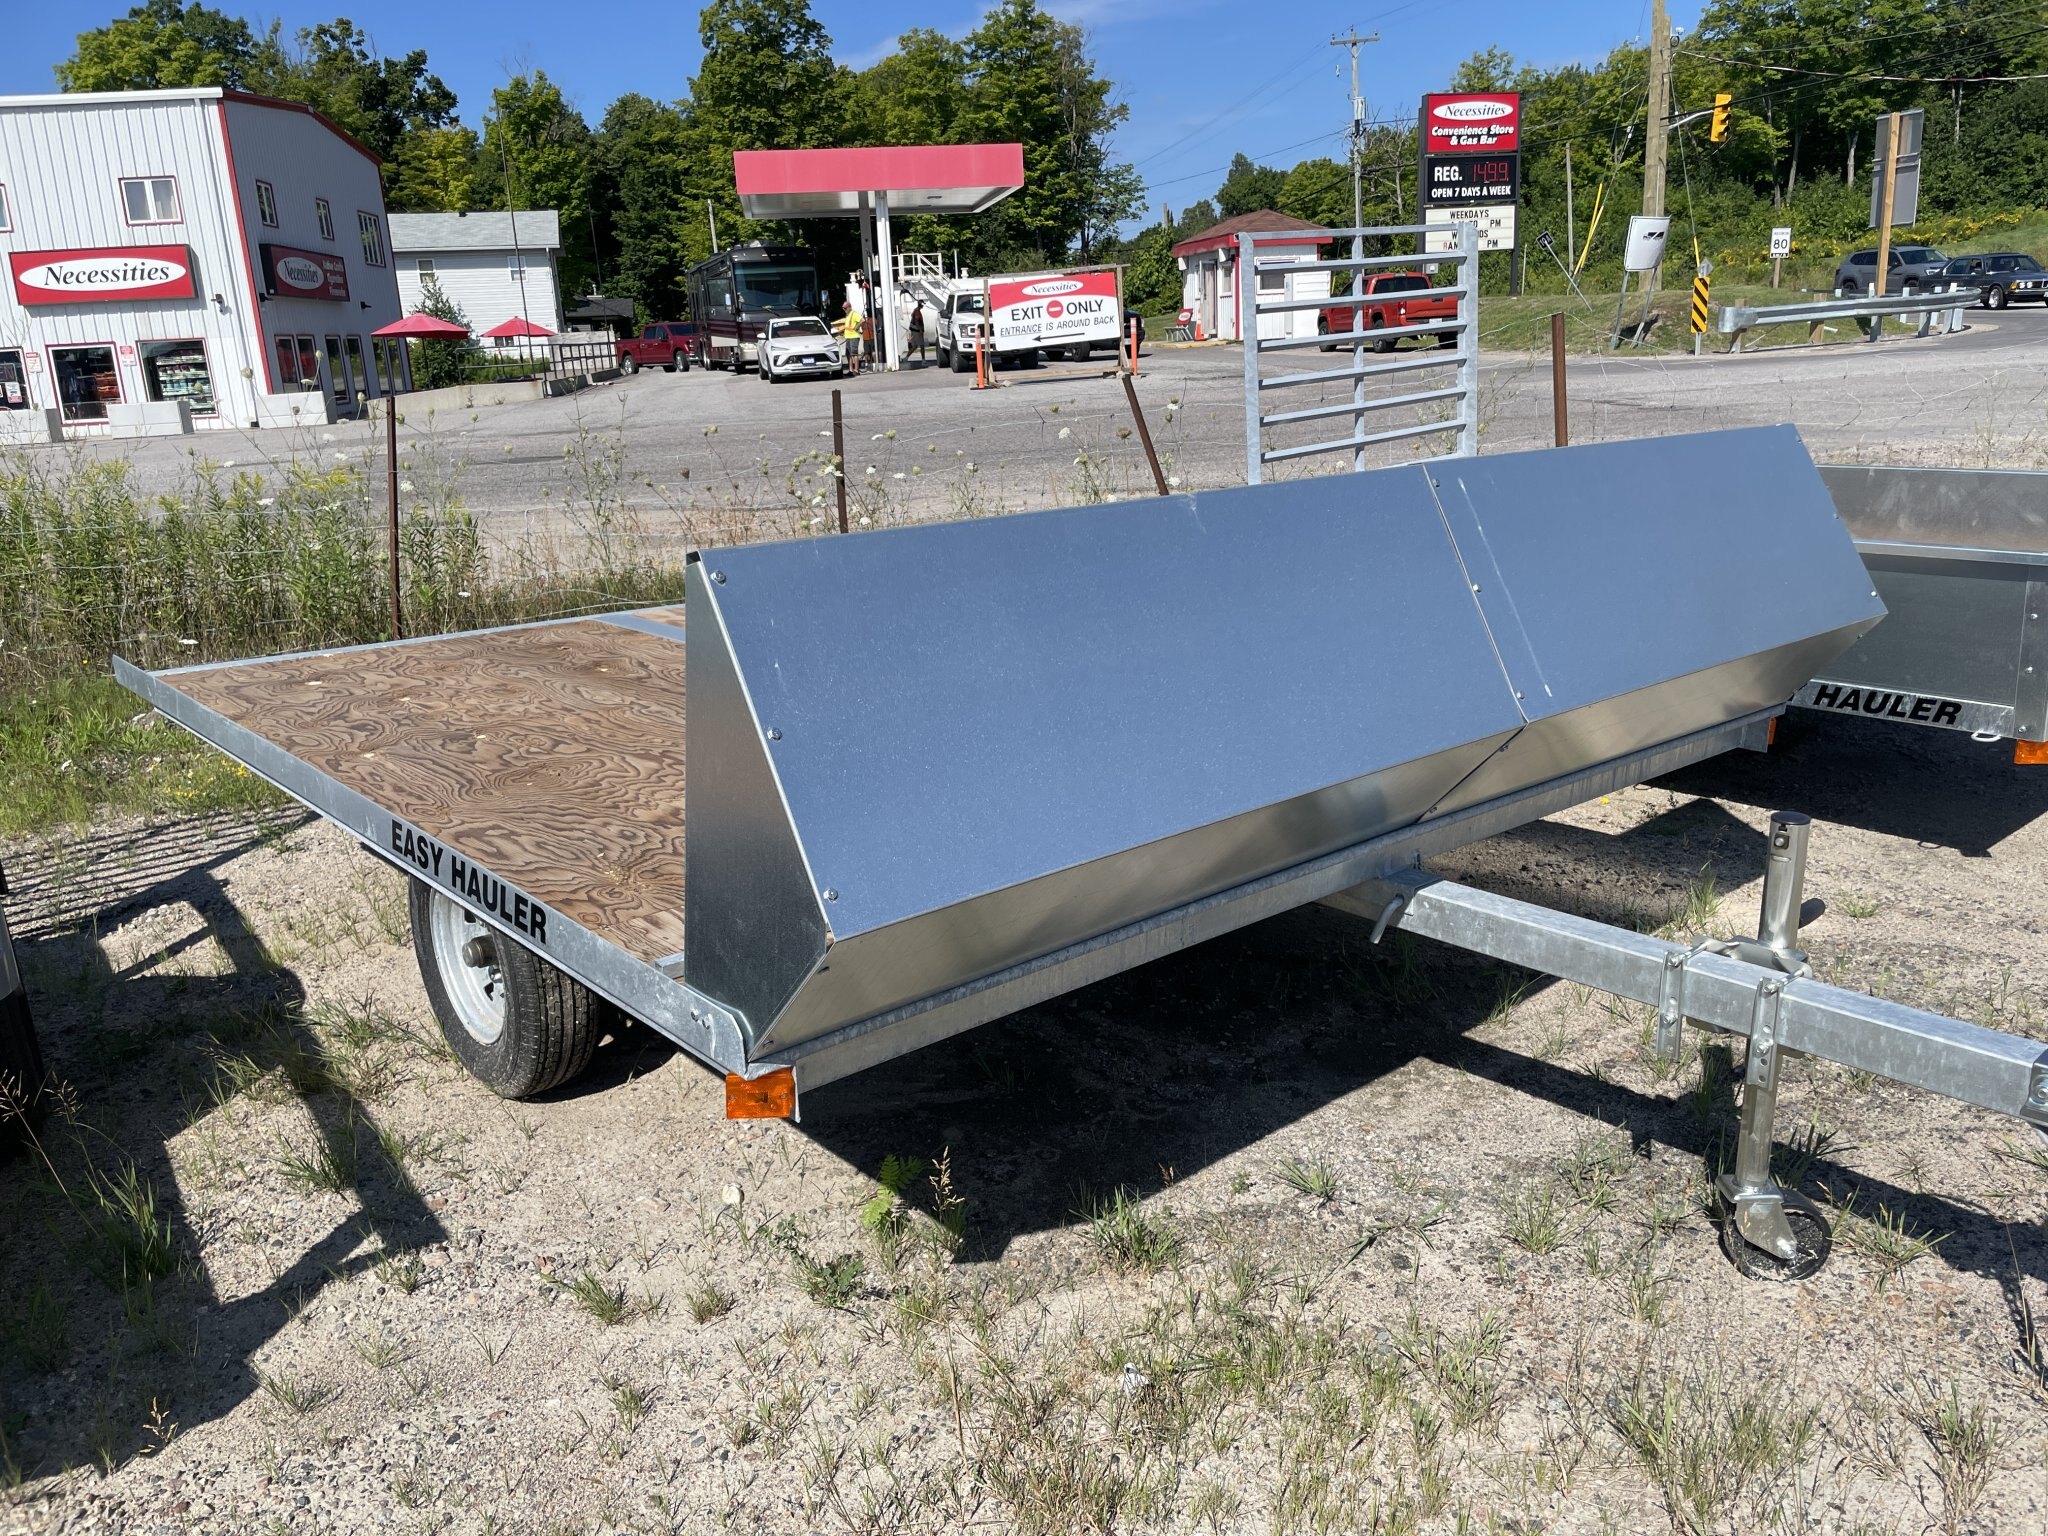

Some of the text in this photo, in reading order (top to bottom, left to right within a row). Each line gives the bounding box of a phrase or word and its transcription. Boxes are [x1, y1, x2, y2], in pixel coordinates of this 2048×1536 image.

[1444, 104, 1506, 117] Necessities
[1431, 124, 1514, 136] Convenience Store
[1450, 135, 1498, 146] & Gas Bar
[1434, 165, 1463, 182] REG.
[1431, 185, 1511, 198] OPEN 7 DAYS A WEEK
[1450, 209, 1489, 219] WEEKDAYS
[1490, 219, 1501, 228] PM
[1487, 239, 1498, 248] PM
[1773, 238, 1788, 249] 80
[44, 262, 170, 286] Necessities
[283, 260, 319, 284] Necessities
[1031, 281, 1078, 294] Necessities
[1011, 299, 1104, 321] EXIT ONLY
[1000, 315, 1115, 336] ENTRANCE IS AROUND BACK
[1813, 684, 1962, 725] HAULER
[391, 819, 546, 944] EASY HAULER
